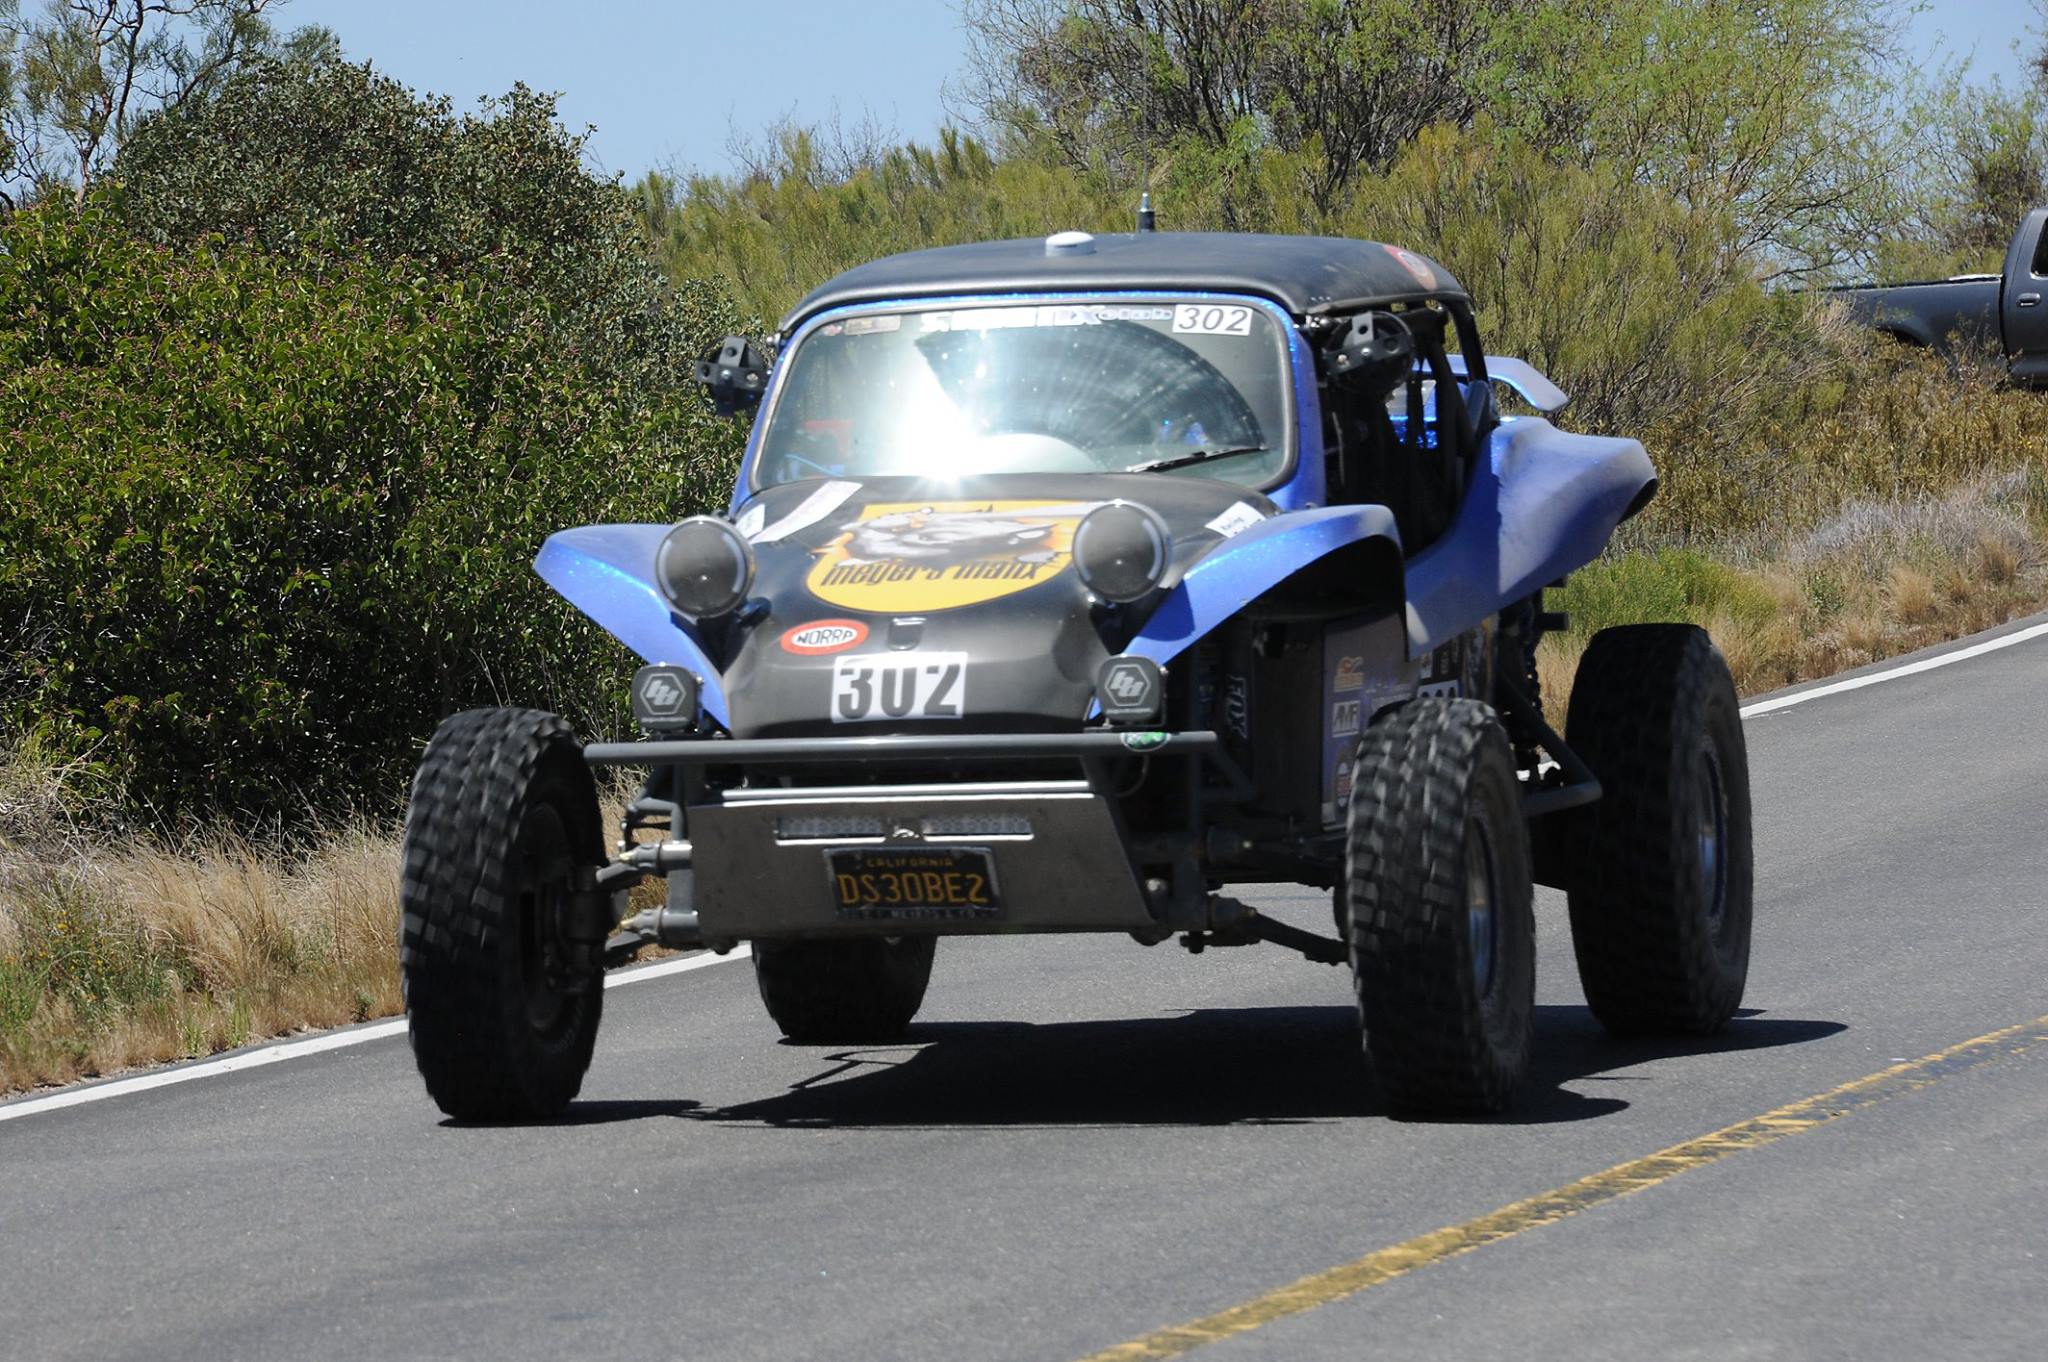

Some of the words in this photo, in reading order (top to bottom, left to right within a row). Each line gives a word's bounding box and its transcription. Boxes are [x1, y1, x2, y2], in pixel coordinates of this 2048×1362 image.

[1178, 307, 1249, 332] 302
[838, 664, 961, 718] 302
[866, 857, 955, 868] CALIFORNIA
